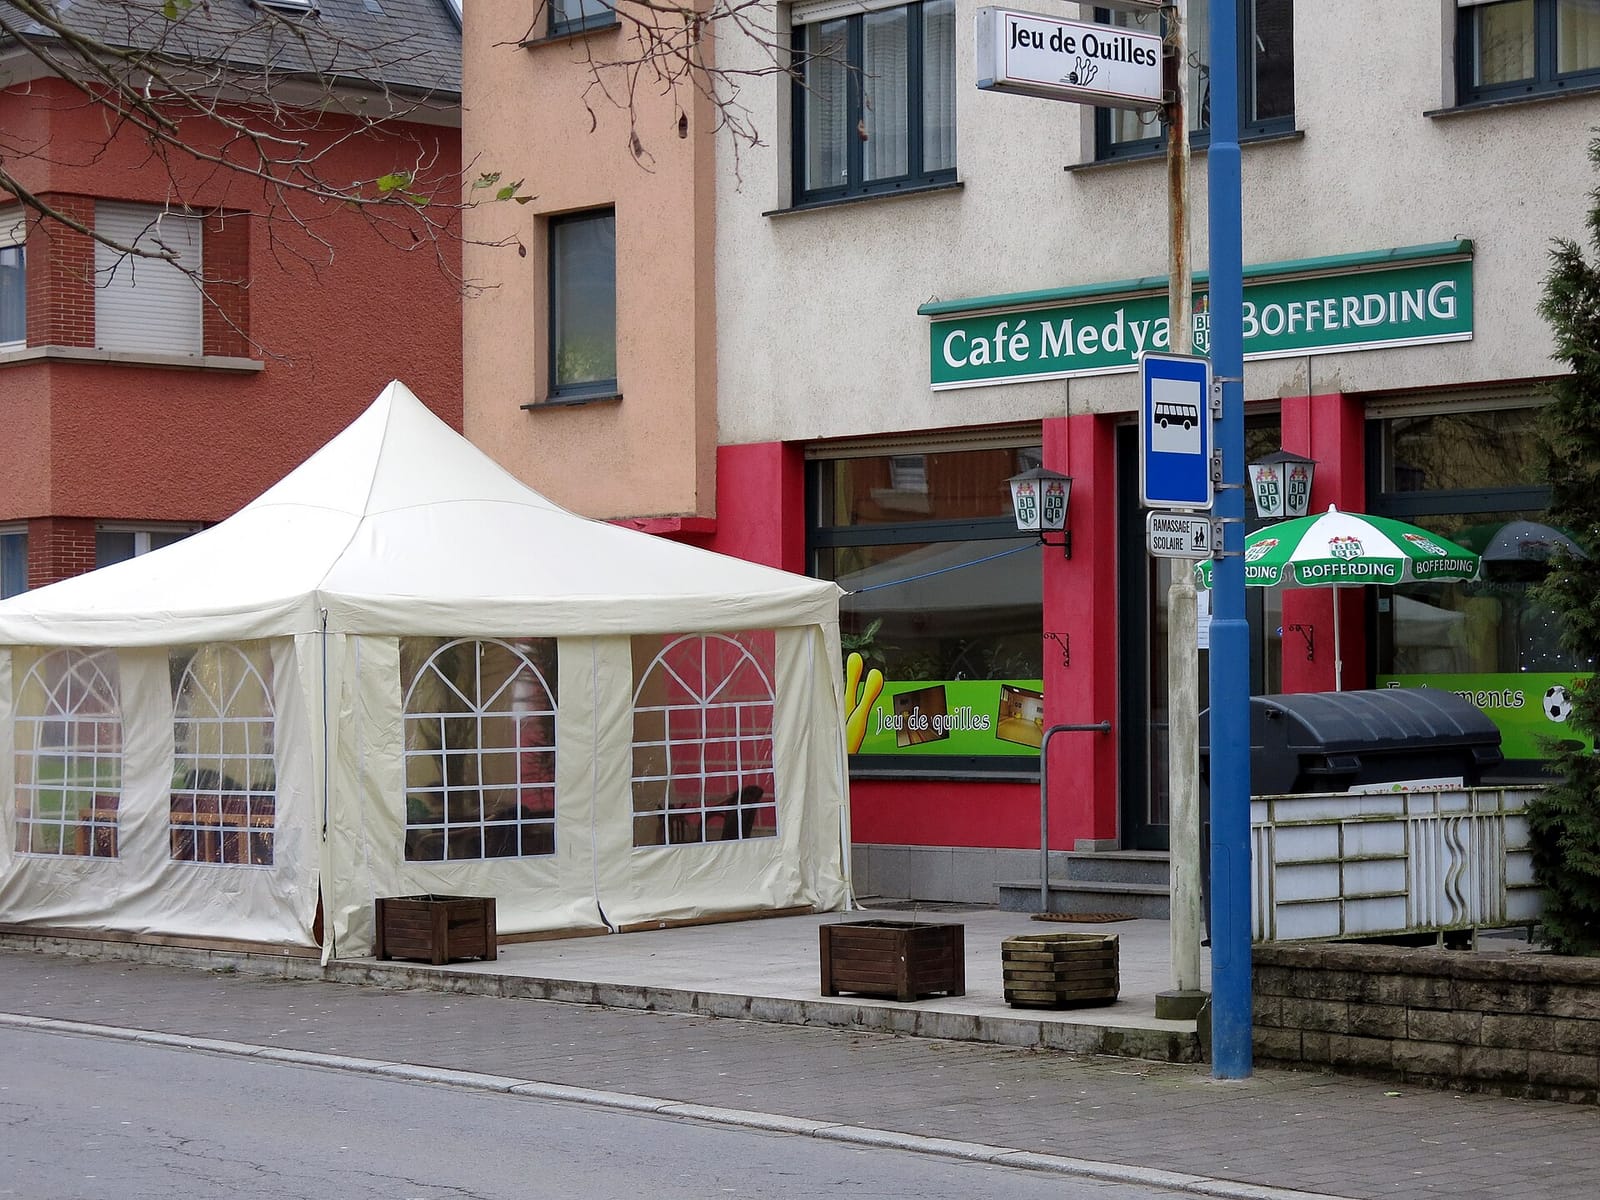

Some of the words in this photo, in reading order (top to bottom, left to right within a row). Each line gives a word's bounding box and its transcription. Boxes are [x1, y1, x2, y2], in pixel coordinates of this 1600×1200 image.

[1011, 22, 1044, 50] Jeu
[1050, 27, 1076, 54] de
[1082, 34, 1157, 67] Quilles
[1243, 280, 1458, 338] BOFFERDING
[943, 319, 1030, 368] Café
[1038, 308, 1170, 360] Medya
[1153, 518, 1190, 534] RAMASSAGE
[1153, 536, 1184, 551] SCOLAIRE
[1302, 563, 1395, 578] BOFFERDING
[1416, 559, 1473, 574] BOFFERDING
[875, 706, 903, 736] Jeu
[907, 706, 928, 730] de
[932, 707, 991, 736] quilles
